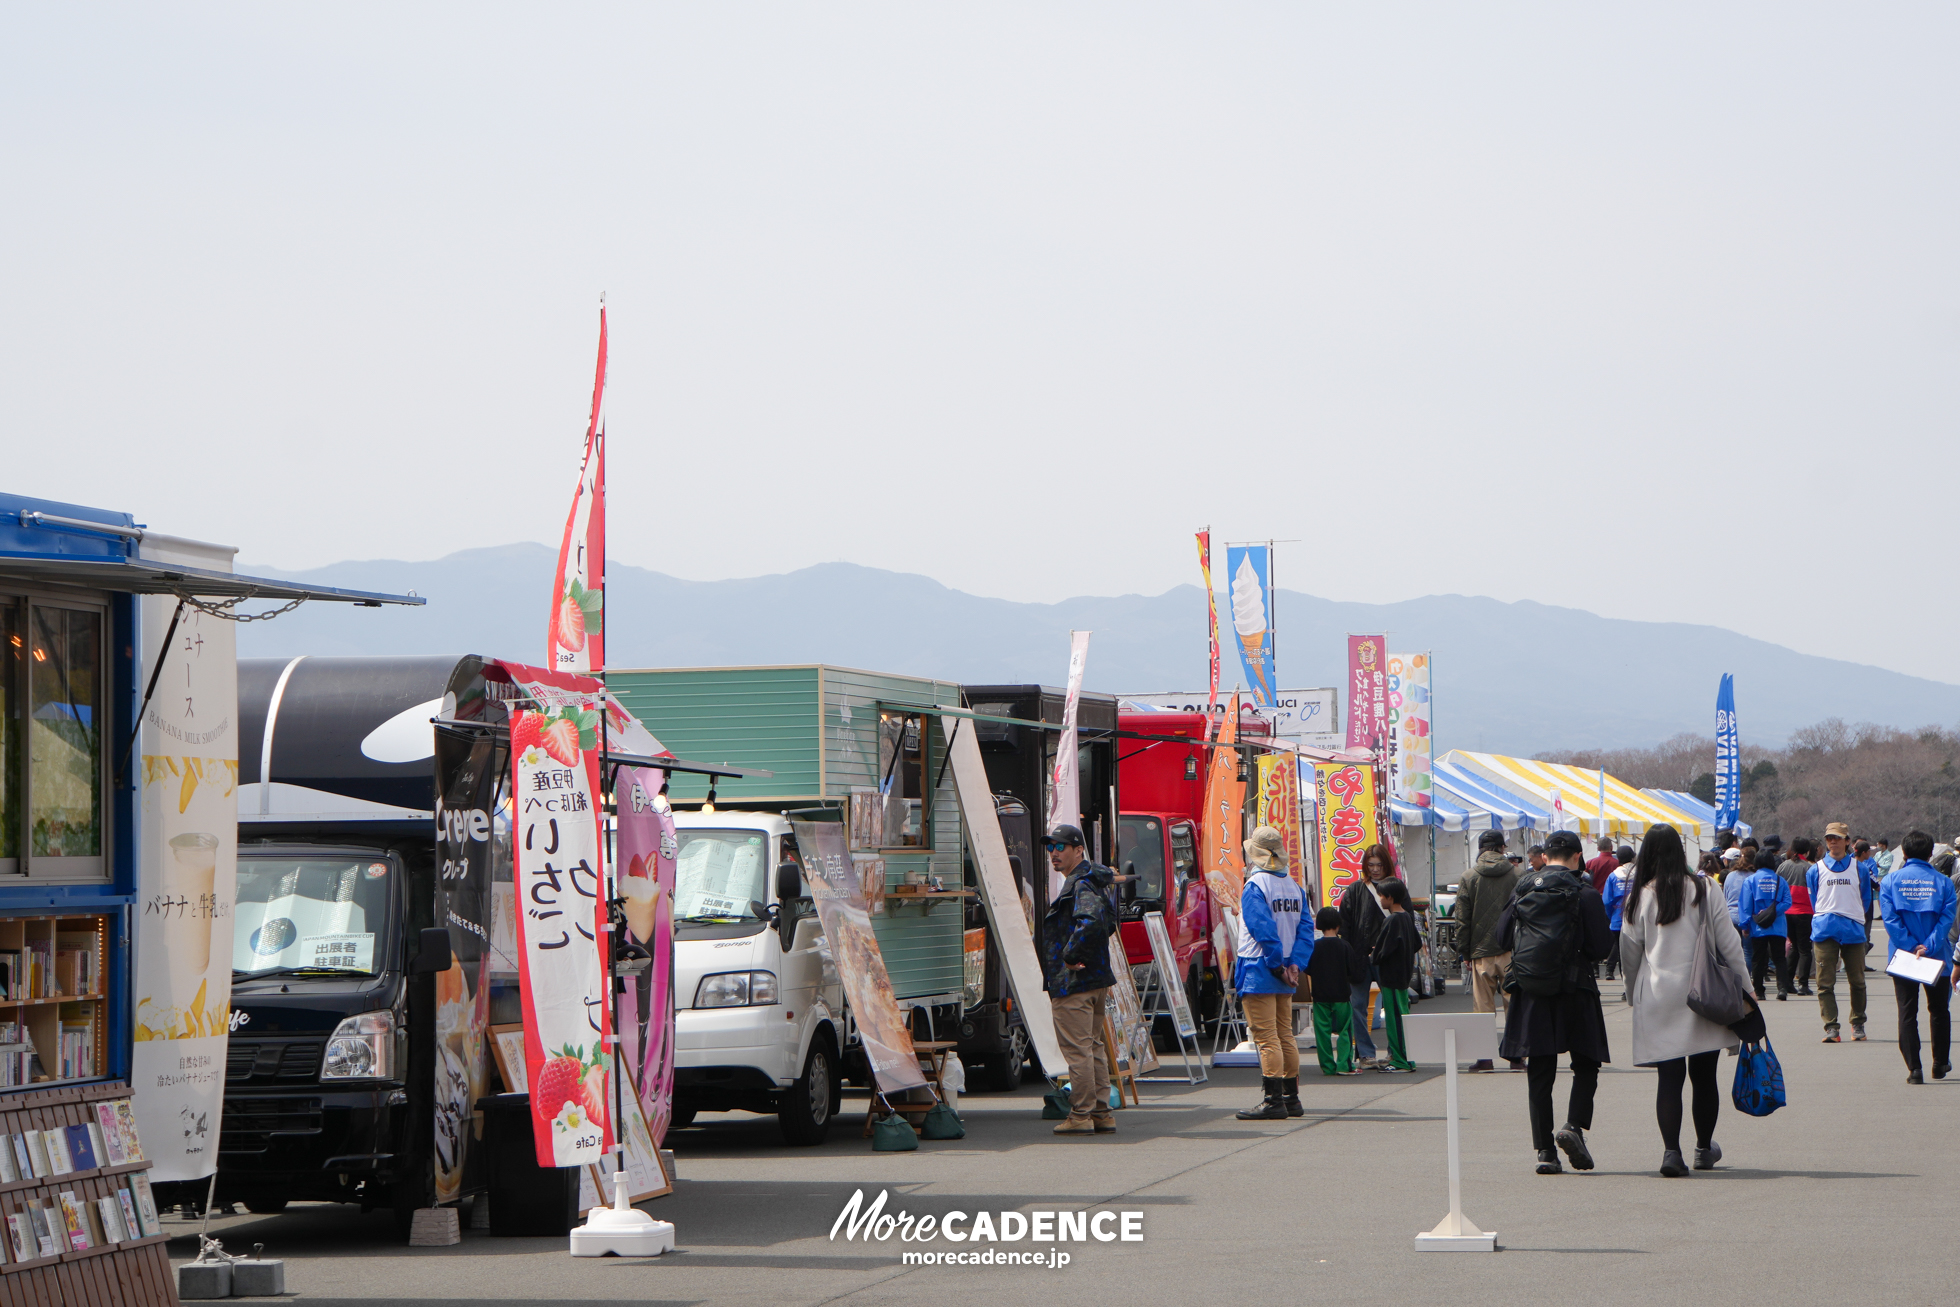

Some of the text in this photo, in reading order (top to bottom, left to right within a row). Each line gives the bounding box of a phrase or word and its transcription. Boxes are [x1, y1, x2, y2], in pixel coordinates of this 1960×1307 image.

[1276, 699, 1297, 708] UCI
[149, 710, 182, 741] BANANA
[184, 731, 201, 745] MILK
[1714, 734, 1729, 812] YAMAHA
[436, 795, 490, 855] Crepe
[442, 857, 469, 880] クレープ
[804, 854, 845, 880] チキン南蛮
[315, 941, 357, 955] 出展者
[313, 955, 356, 967] 駐車証
